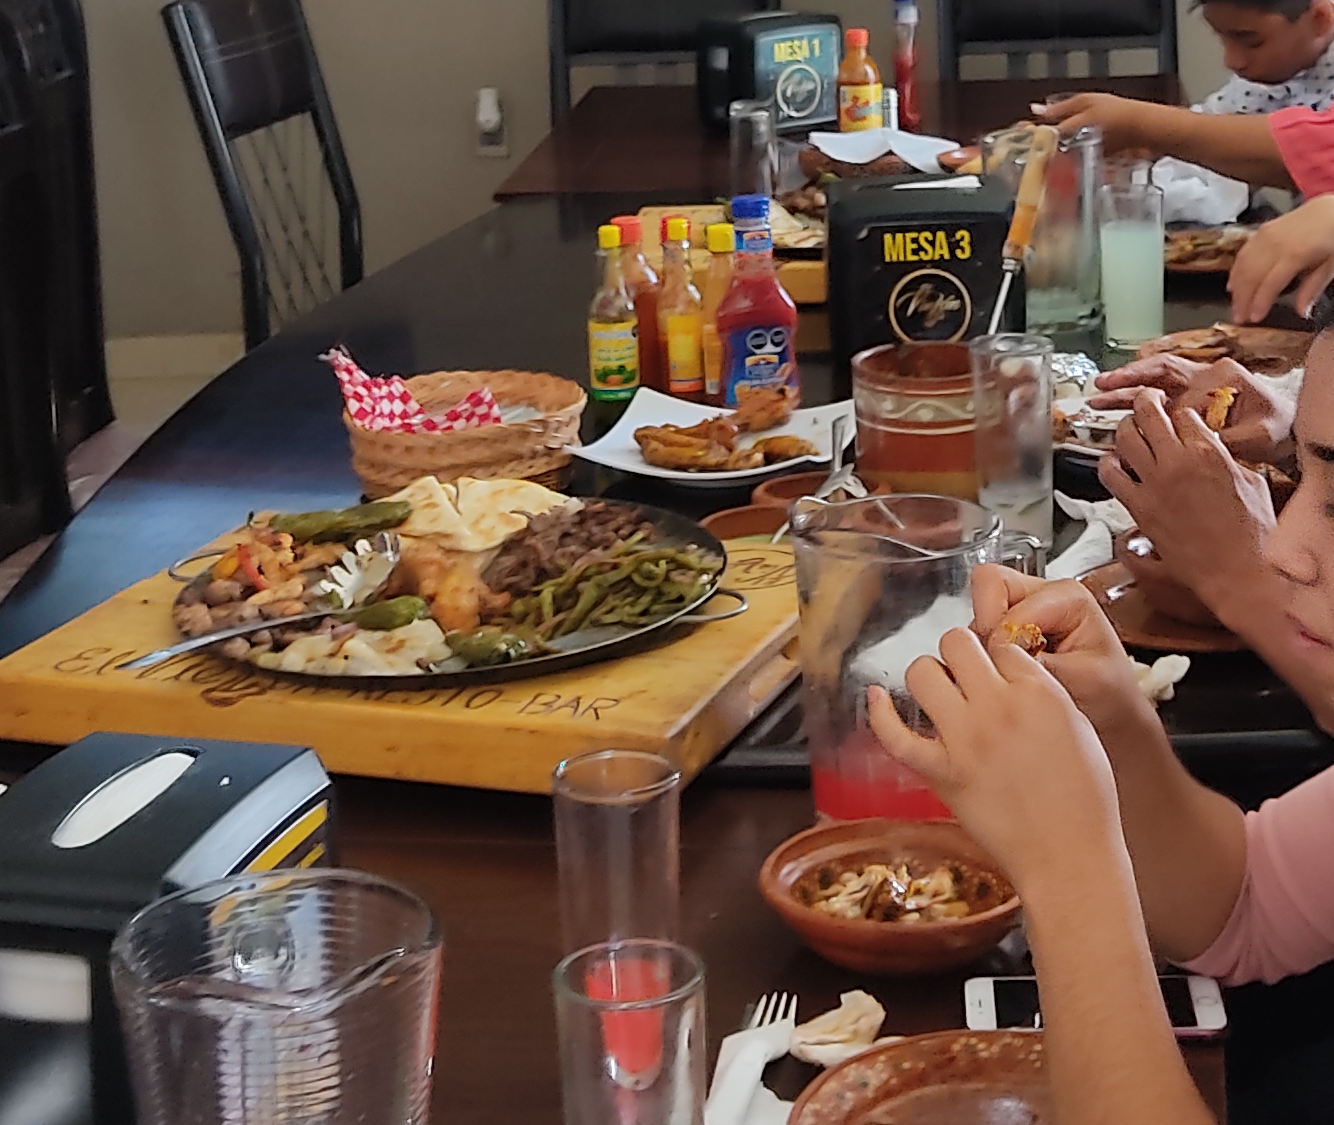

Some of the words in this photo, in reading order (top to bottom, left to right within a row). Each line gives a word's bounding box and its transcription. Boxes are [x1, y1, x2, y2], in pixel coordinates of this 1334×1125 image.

[773, 37, 809, 63] MESA
[812, 38, 820, 57] 1
[883, 231, 950, 263] MESA
[954, 229, 972, 260] 3
